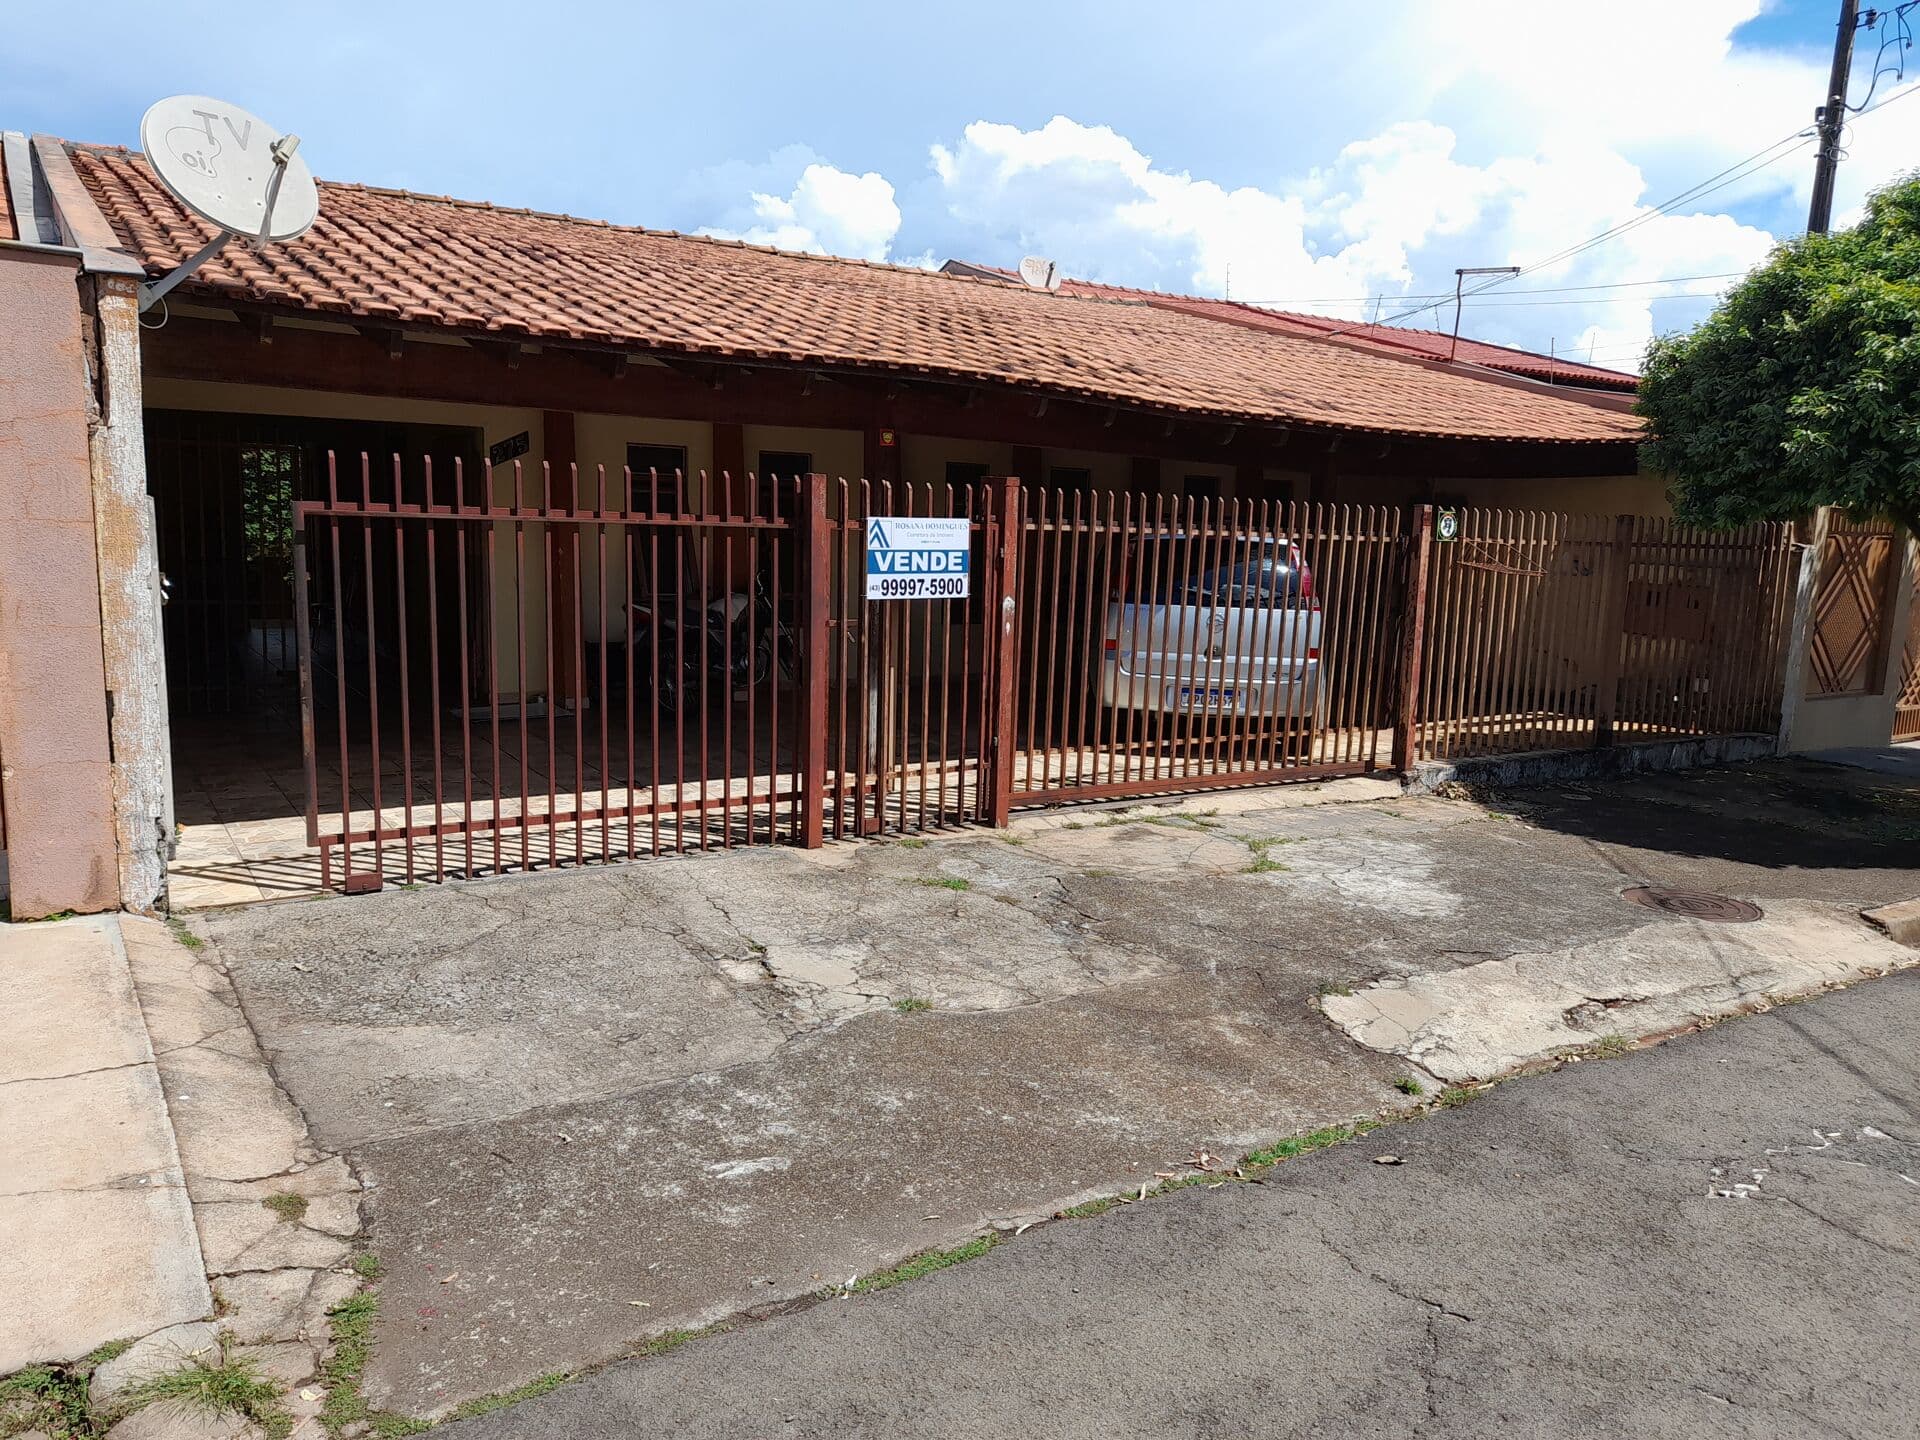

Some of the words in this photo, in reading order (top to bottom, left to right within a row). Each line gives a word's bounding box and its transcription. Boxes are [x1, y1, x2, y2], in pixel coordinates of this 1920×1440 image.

[193, 109, 251, 151] TV
[895, 522, 924, 530] ROSANA
[874, 551, 963, 572] VENDE
[881, 578, 963, 596] 99997-5900
